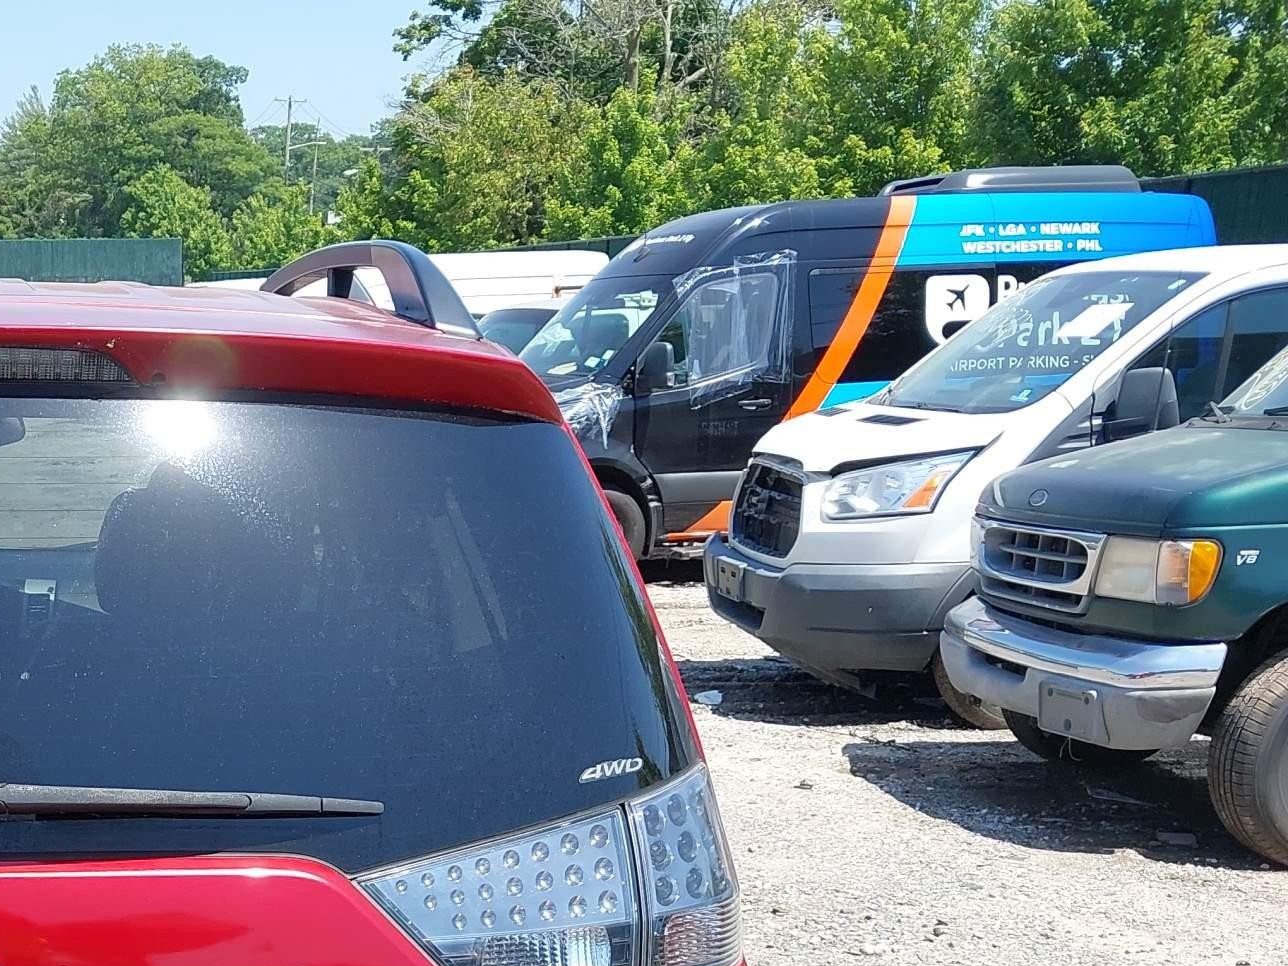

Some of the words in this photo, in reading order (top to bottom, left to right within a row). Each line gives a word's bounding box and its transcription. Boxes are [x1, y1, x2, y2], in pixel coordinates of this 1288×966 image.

[960, 224, 985, 237] JFK
[998, 224, 1027, 236] LGA
[1039, 222, 1101, 235] NEWARK
[962, 239, 1063, 254] WESTCHESTER
[1076, 238, 1103, 252] PHL
[1236, 554, 1258, 566] V8
[578, 757, 643, 784] 4WD
